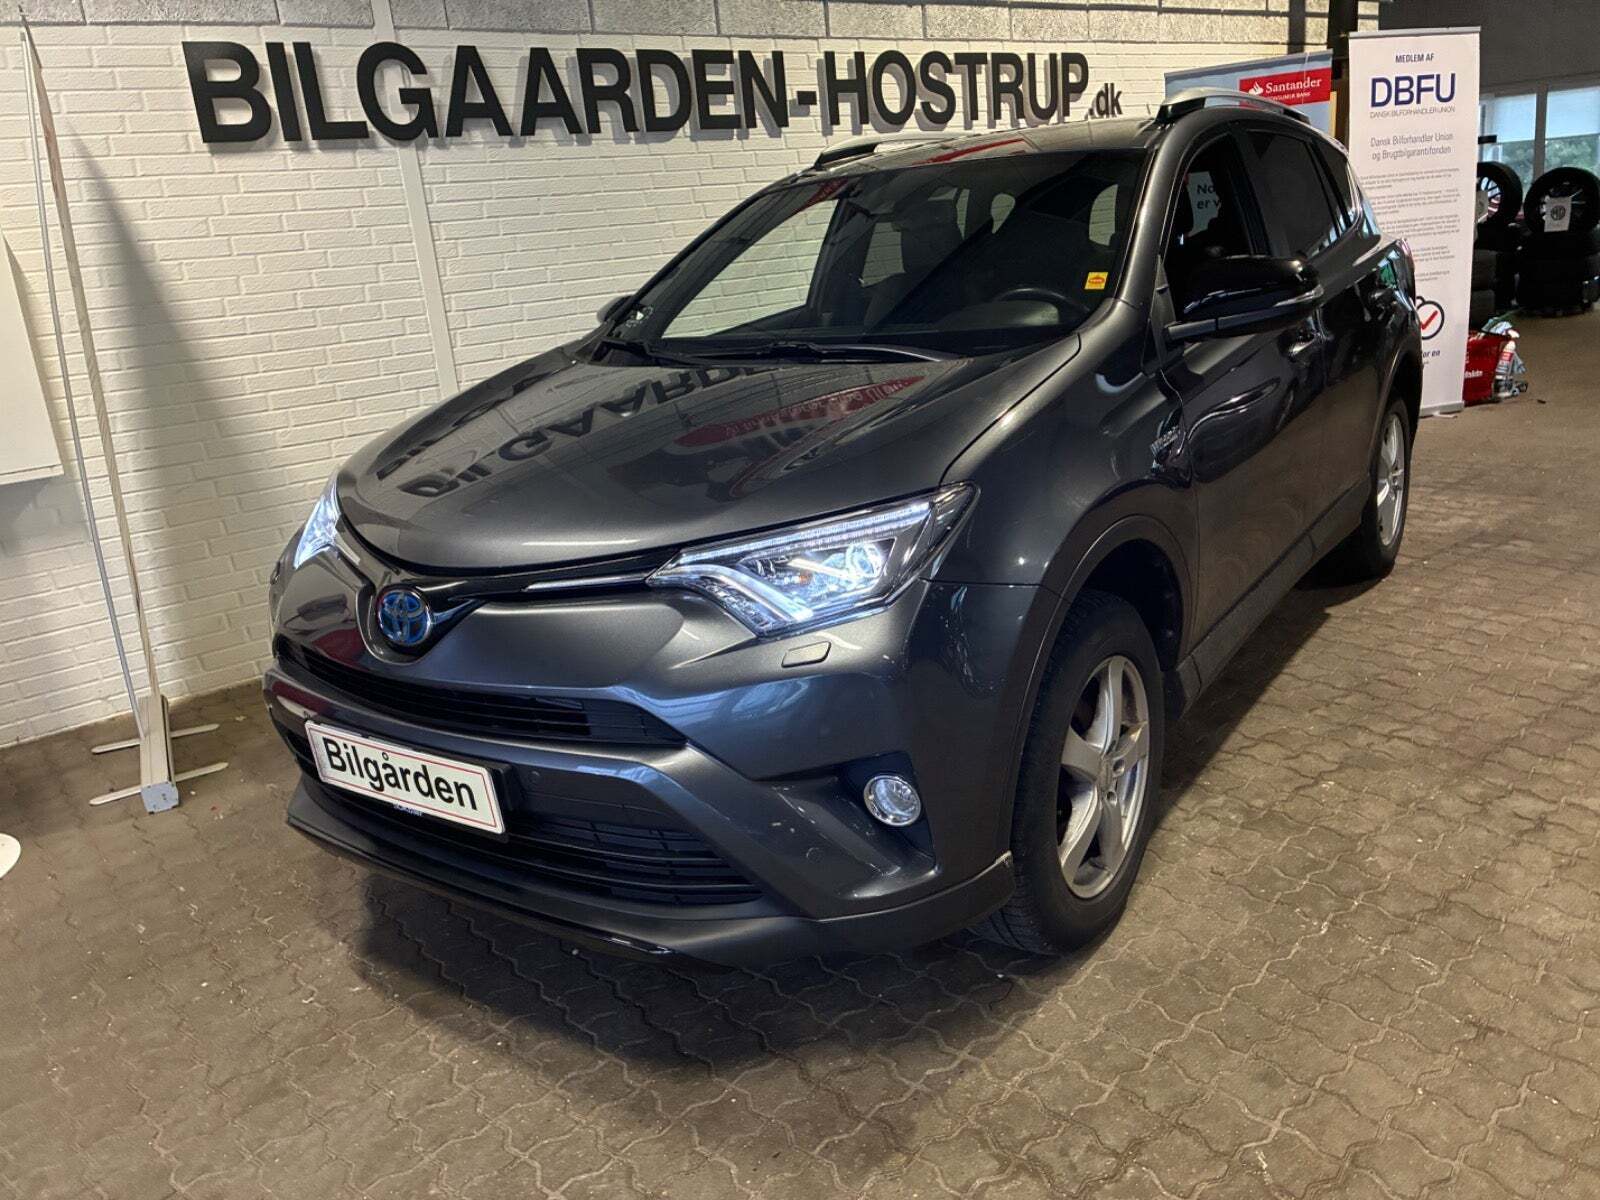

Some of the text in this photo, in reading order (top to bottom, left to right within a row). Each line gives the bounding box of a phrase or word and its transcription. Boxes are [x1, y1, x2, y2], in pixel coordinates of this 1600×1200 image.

[1395, 52, 1434, 63] MEDLEM AF
[1265, 76, 1322, 94] Santander
[1371, 73, 1456, 107] DBFU
[1370, 132, 1453, 147] Dansk Bilforhandler Union
[1372, 152, 1380, 161] og
[322, 737, 478, 811] Bilgården
